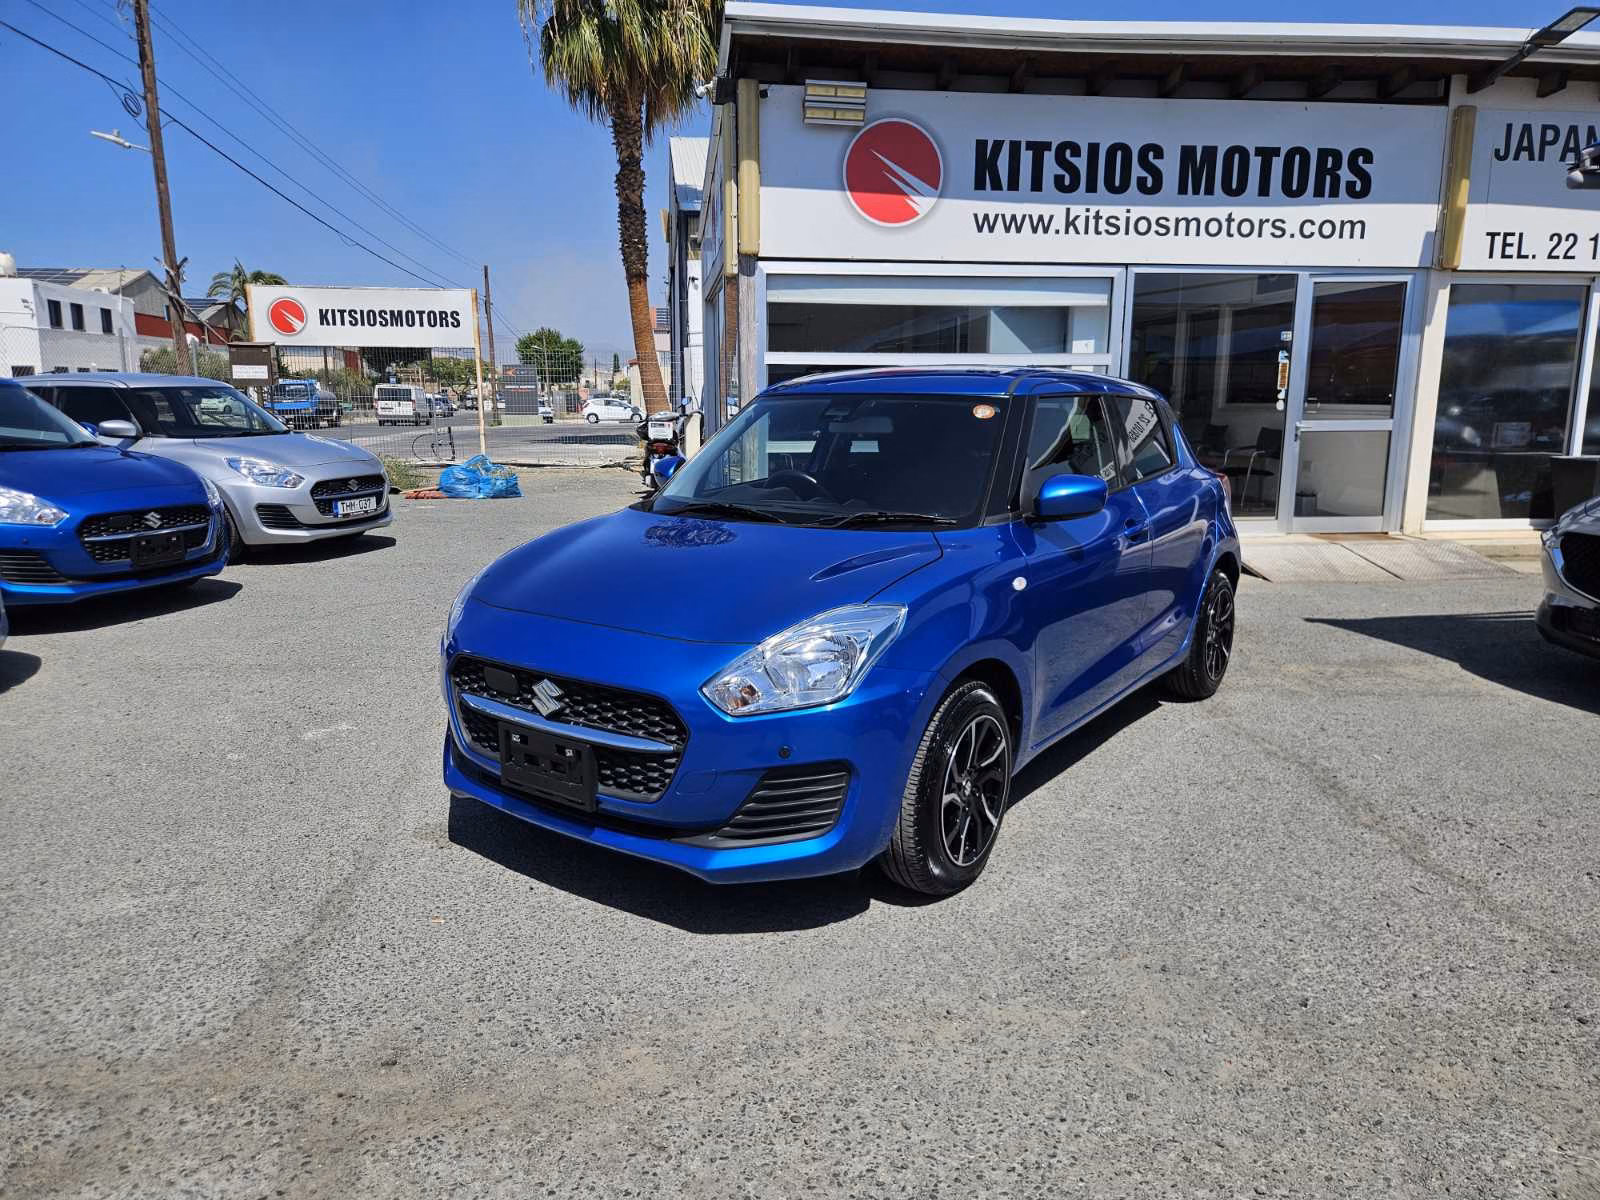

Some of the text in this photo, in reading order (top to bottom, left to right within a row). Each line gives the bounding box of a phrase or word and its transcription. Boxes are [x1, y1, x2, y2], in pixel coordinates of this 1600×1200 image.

[973, 139, 1374, 199] KITSIOS MOTORS
[973, 207, 1367, 240] www.kitsiosmotors.com
[1485, 231, 1536, 260] TEL.
[1546, 232, 1579, 260] 22
[318, 308, 461, 328] KITSIOSMOTORS
